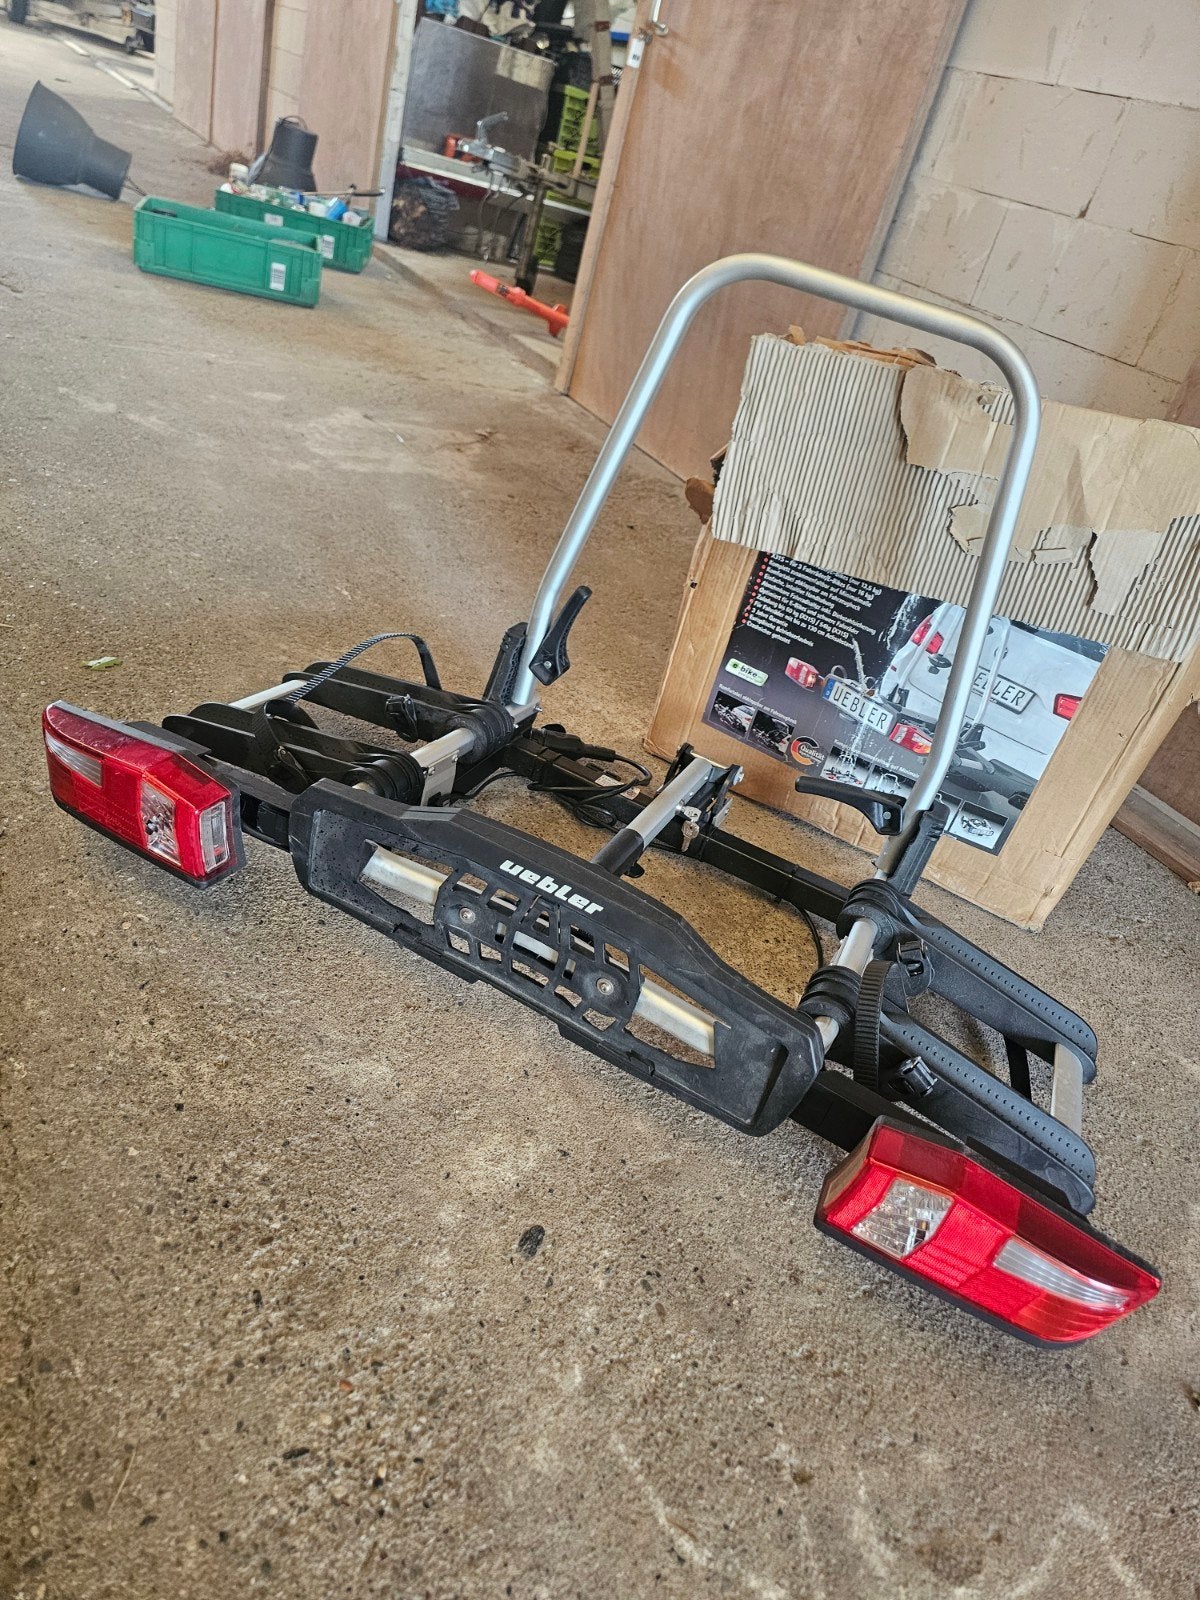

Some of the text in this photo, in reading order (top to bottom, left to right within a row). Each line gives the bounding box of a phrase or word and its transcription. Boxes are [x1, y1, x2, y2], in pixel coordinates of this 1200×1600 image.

[833, 686, 888, 730] UEBLER
[800, 744, 825, 761] Qualität
[499, 859, 604, 915] uebler
